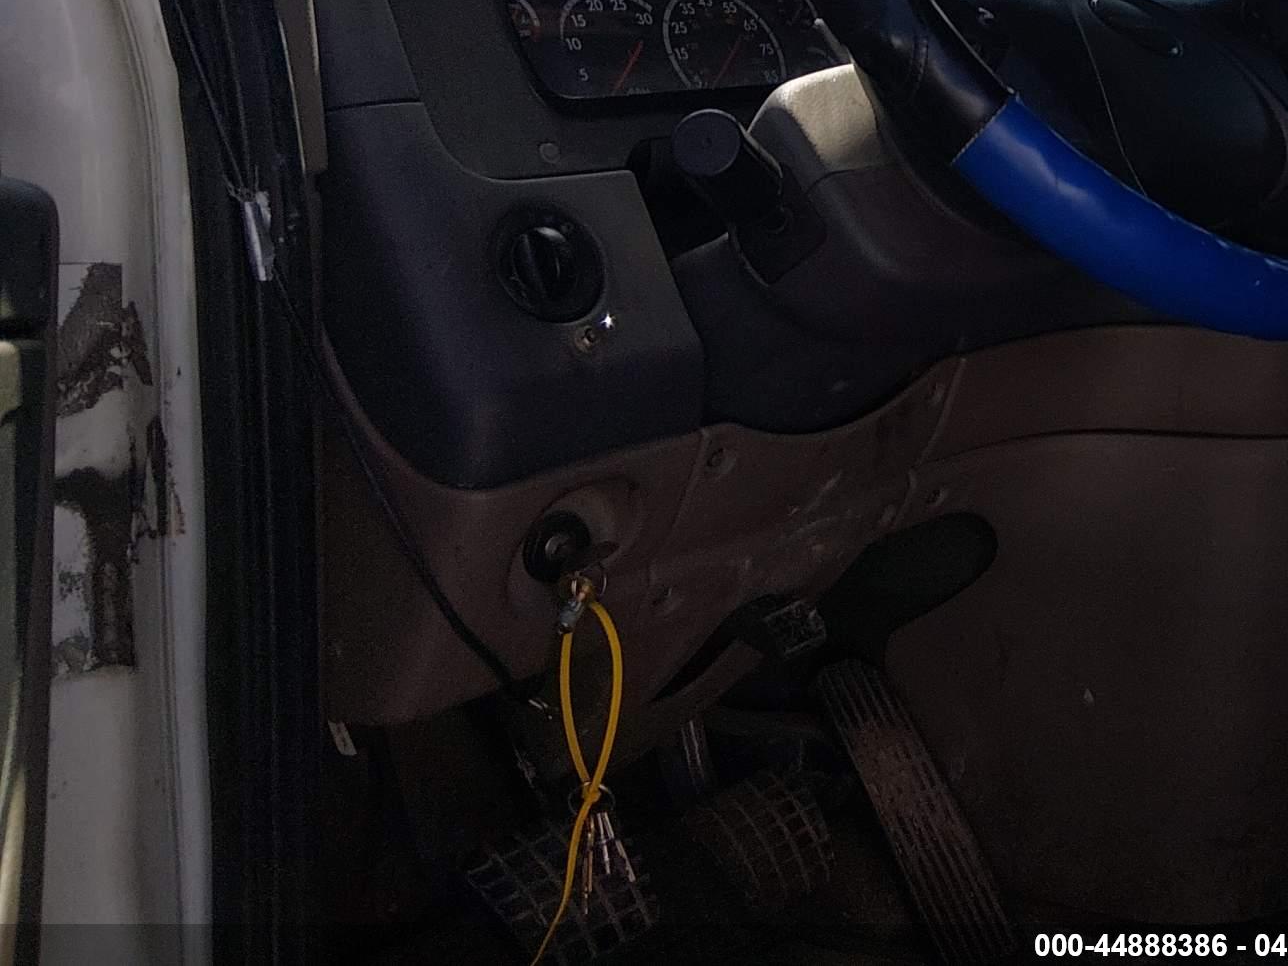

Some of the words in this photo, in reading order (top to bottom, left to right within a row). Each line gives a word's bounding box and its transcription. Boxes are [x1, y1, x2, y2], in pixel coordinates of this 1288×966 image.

[680, 2, 696, 16] 35
[722, 1, 737, 14] 55
[571, 14, 586, 28] 15
[635, 12, 653, 26] 30
[743, 17, 758, 32] 65
[671, 21, 688, 35] 25
[566, 37, 583, 51] 10
[760, 43, 775, 59] 75
[674, 46, 689, 61] 15
[579, 67, 590, 82] 5
